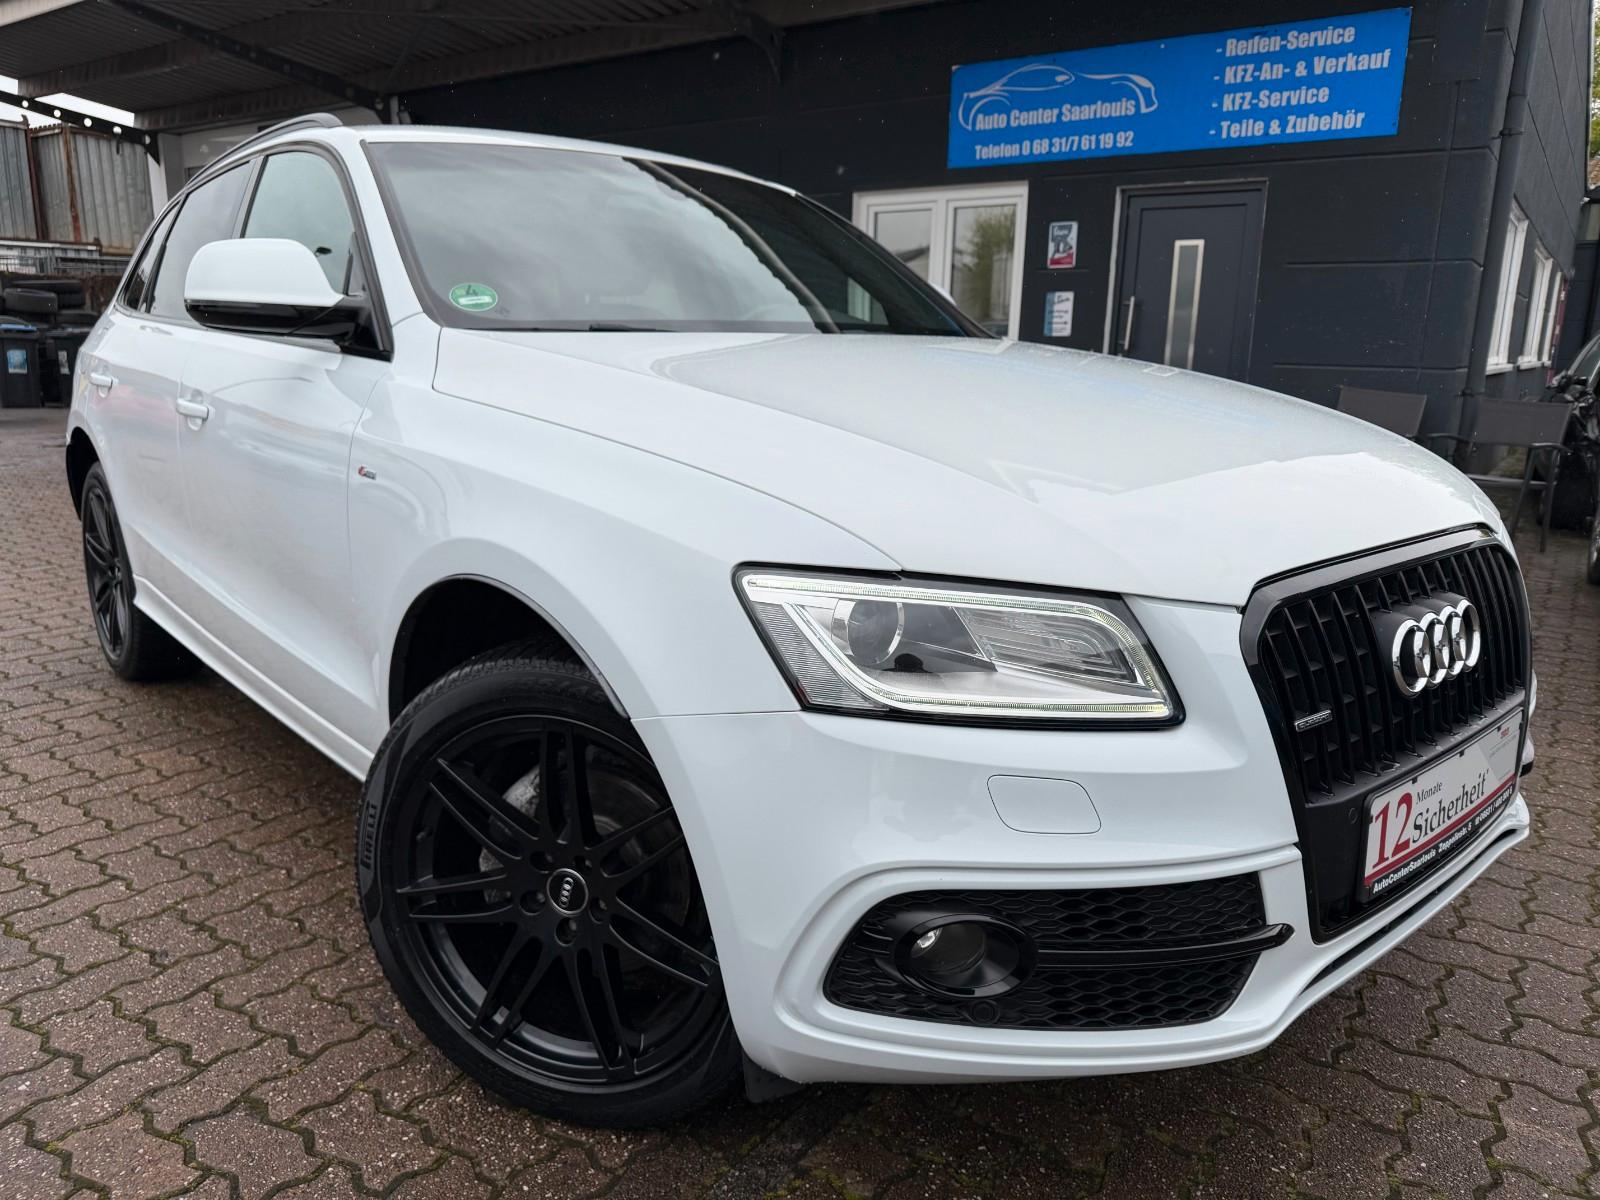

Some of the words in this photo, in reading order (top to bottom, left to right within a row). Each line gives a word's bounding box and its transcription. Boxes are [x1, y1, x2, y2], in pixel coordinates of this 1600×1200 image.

[1226, 26, 1355, 56] Reifen-Service
[1224, 62, 1290, 84] KFZ-An-
[1295, 61, 1307, 77] &
[1313, 48, 1391, 75] Verkauf
[975, 113, 1007, 131] Auto
[1010, 107, 1059, 127] Center
[1062, 97, 1136, 122] Saarlouis
[1222, 86, 1329, 112] KFZ-Service
[1220, 119, 1264, 139] Teile
[1268, 119, 1281, 135] &
[1286, 109, 1365, 133] Zubehör
[975, 143, 1019, 160] Telefon
[1022, 140, 1030, 155] 0
[1032, 138, 1049, 154] 68
[1051, 135, 1079, 153] 31/7
[1081, 134, 1096, 150] 61
[1098, 132, 1114, 149] 19
[1116, 130, 1134, 147] 92
[1416, 782, 1442, 804] Monate
[361, 802, 378, 870] PIRELLI
[1372, 792, 1412, 869] 12
